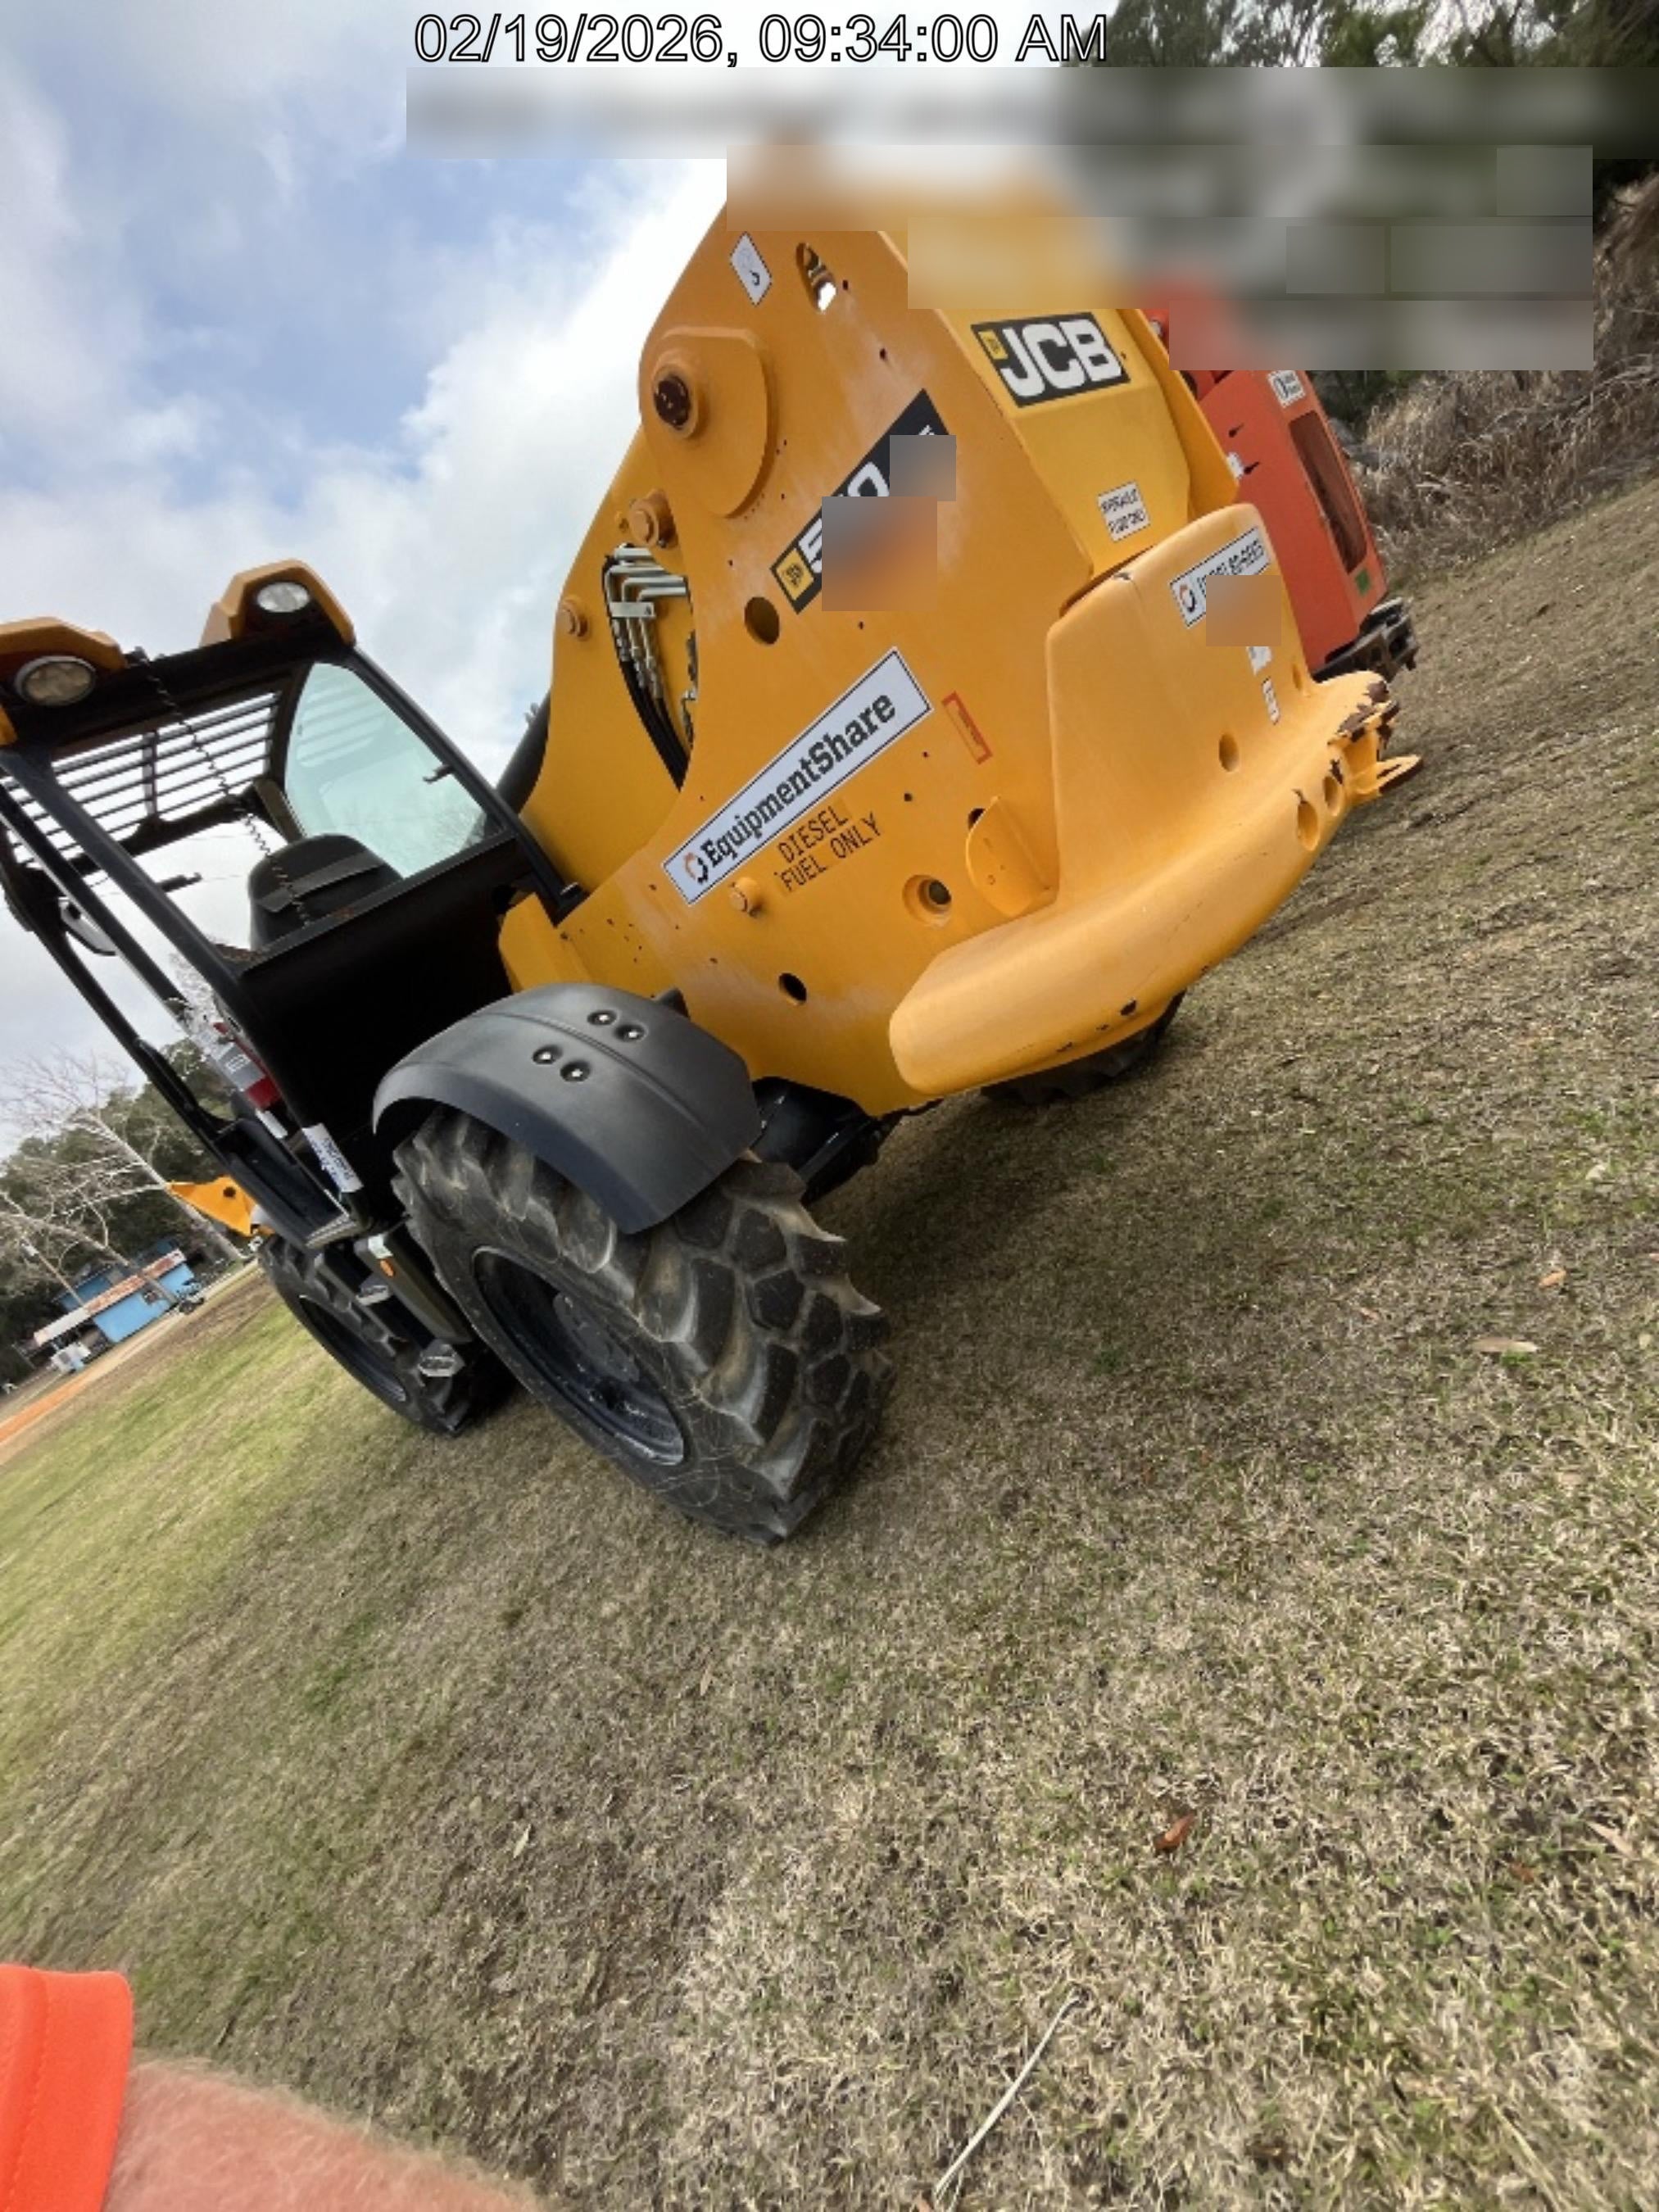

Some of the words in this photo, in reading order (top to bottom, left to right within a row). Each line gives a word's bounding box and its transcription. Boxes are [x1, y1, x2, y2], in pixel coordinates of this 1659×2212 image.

[999, 319, 1123, 397] JCB
[700, 694, 897, 868] EquipmentShare
[777, 805, 849, 863] DIESEL
[780, 854, 827, 893] FUEL
[830, 810, 881, 859] ONLY
